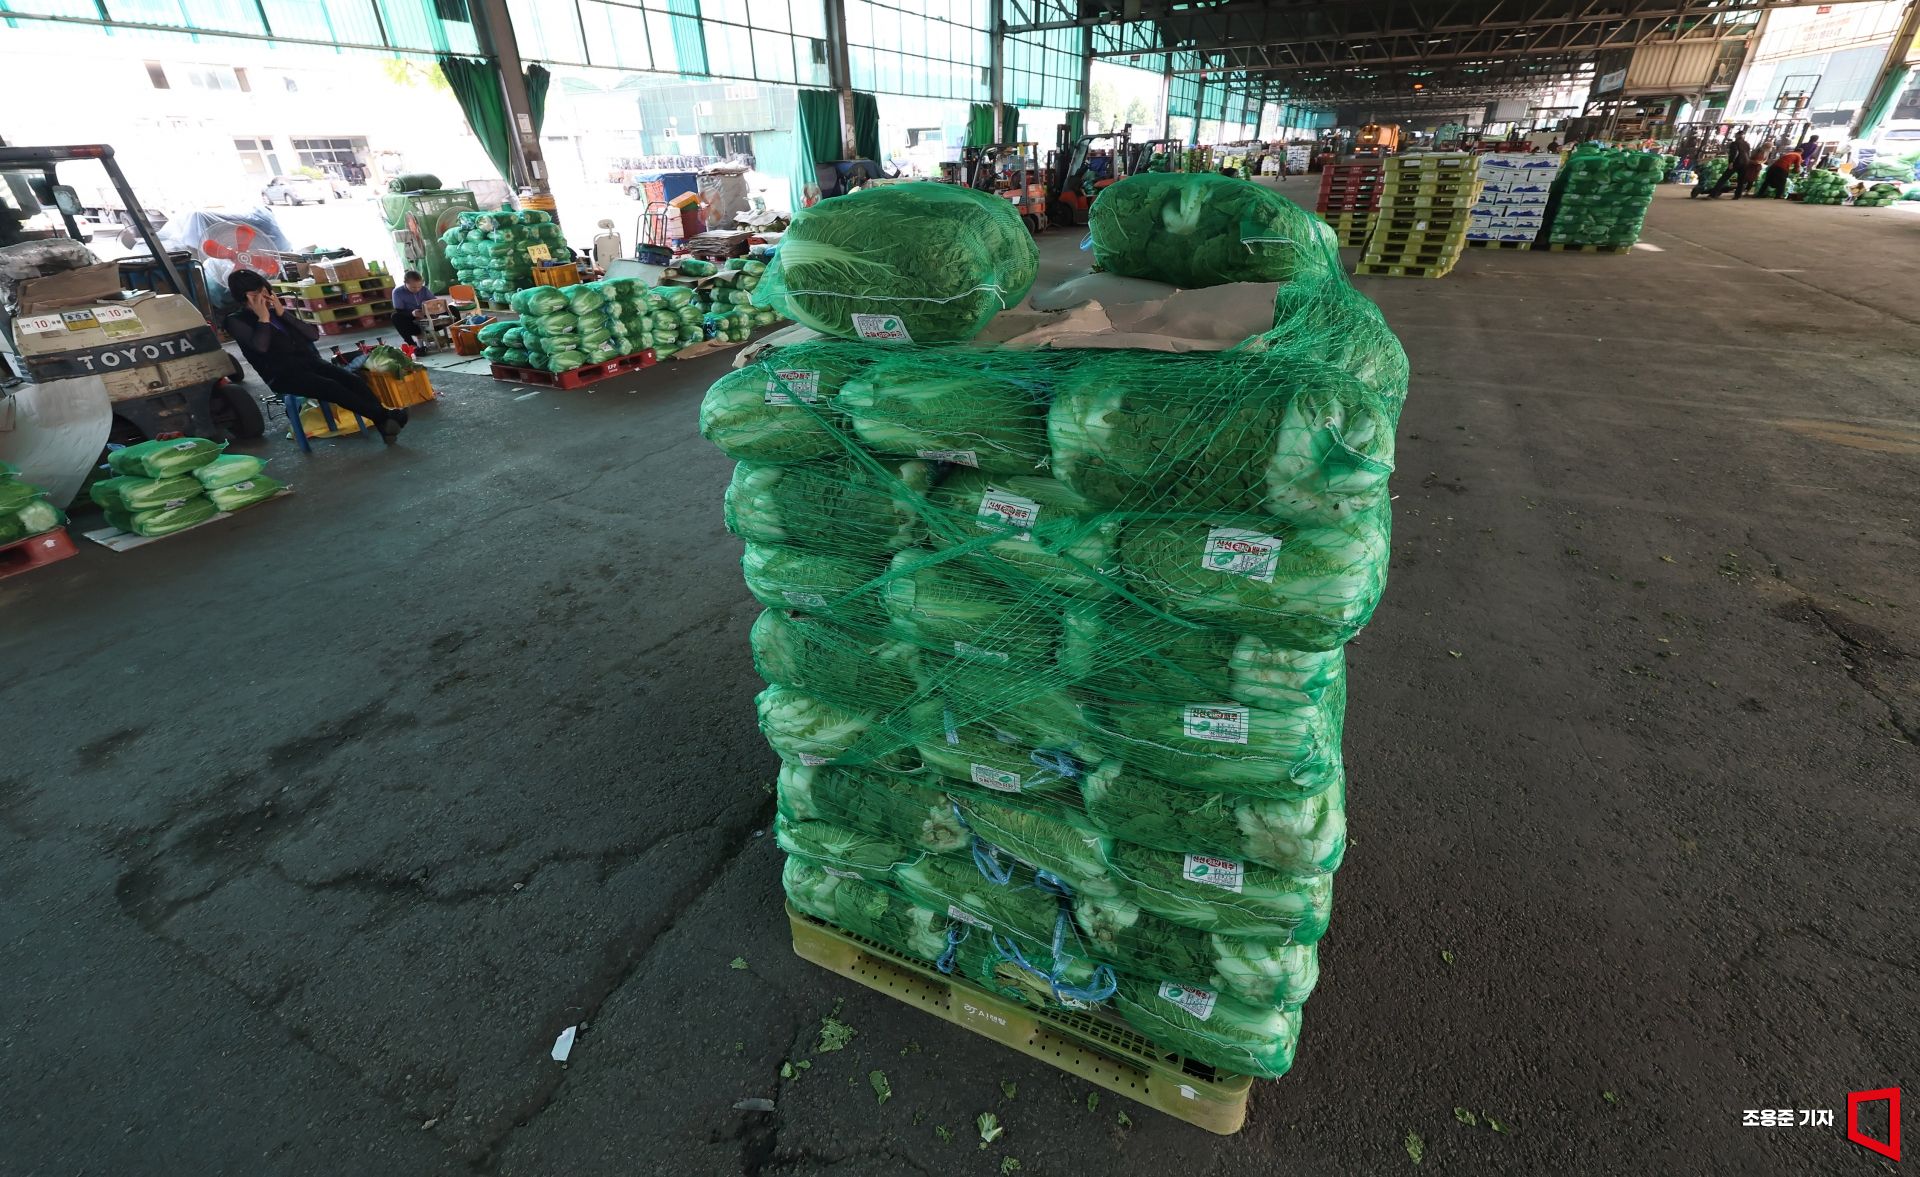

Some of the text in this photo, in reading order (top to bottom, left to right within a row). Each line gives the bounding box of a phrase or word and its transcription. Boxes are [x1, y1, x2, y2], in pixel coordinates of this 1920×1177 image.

[108, 309, 121, 318] 10
[34, 320, 48, 329] 10
[77, 338, 195, 370] TOYOTA
